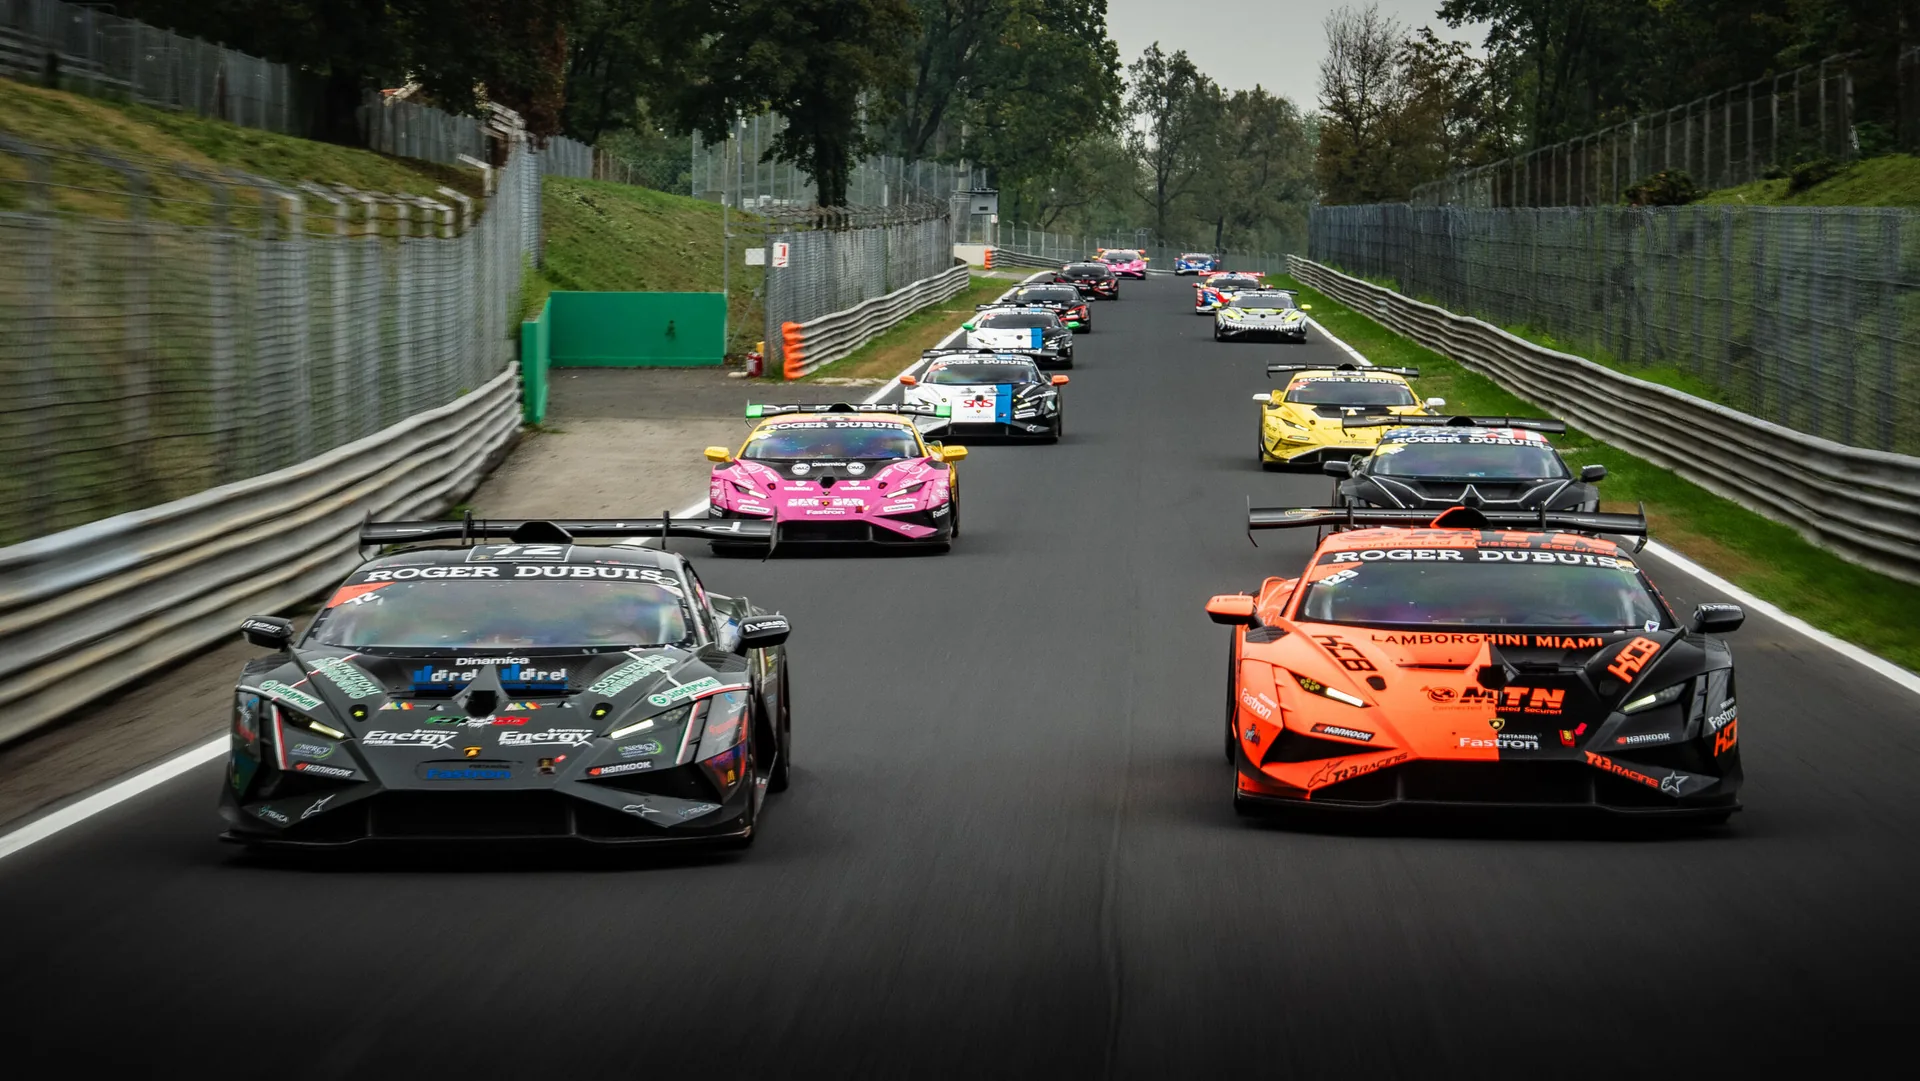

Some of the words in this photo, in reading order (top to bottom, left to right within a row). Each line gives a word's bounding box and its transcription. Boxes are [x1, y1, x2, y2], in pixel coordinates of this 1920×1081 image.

[764, 422, 829, 431] ROGER
[835, 421, 905, 430] DUBUIS
[1392, 436, 1462, 444] ROGER
[1469, 436, 1544, 447] DUBUIS
[1333, 549, 1464, 563] ROGER
[1478, 550, 1618, 568] DUBUIS
[364, 566, 500, 582] ROGER
[515, 565, 663, 582] DUBUIS
[1371, 632, 1529, 647] LAMBORGHINI
[1536, 635, 1604, 650] MIAMI
[455, 656, 531, 666] Dinamica
[1459, 686, 1565, 709] MTN
[362, 730, 458, 745] Energy
[497, 730, 593, 743] Energy
[1459, 737, 1539, 750] Fastron
[426, 767, 512, 780] Fastron
